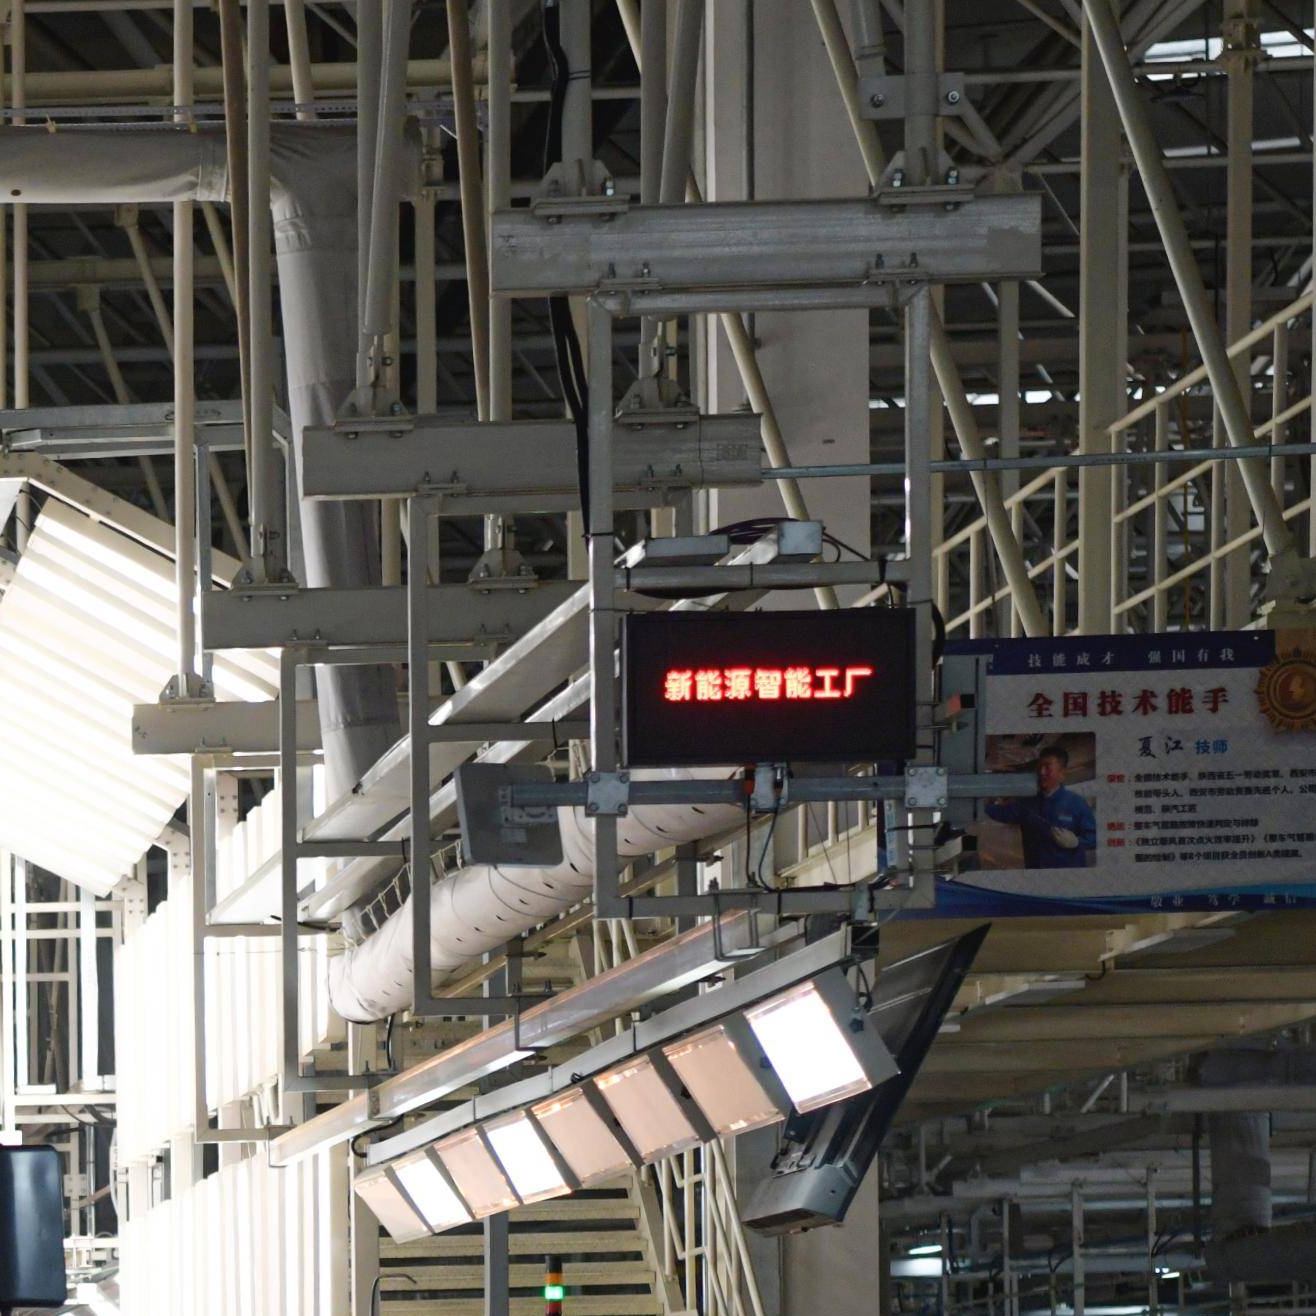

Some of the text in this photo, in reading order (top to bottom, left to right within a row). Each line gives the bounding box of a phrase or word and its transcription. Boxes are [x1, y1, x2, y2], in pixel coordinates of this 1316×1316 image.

[664, 667, 873, 701] 新能源智能工厂
[1026, 686, 1230, 719] 全国技术能手
[1194, 739, 1229, 755] 技师
